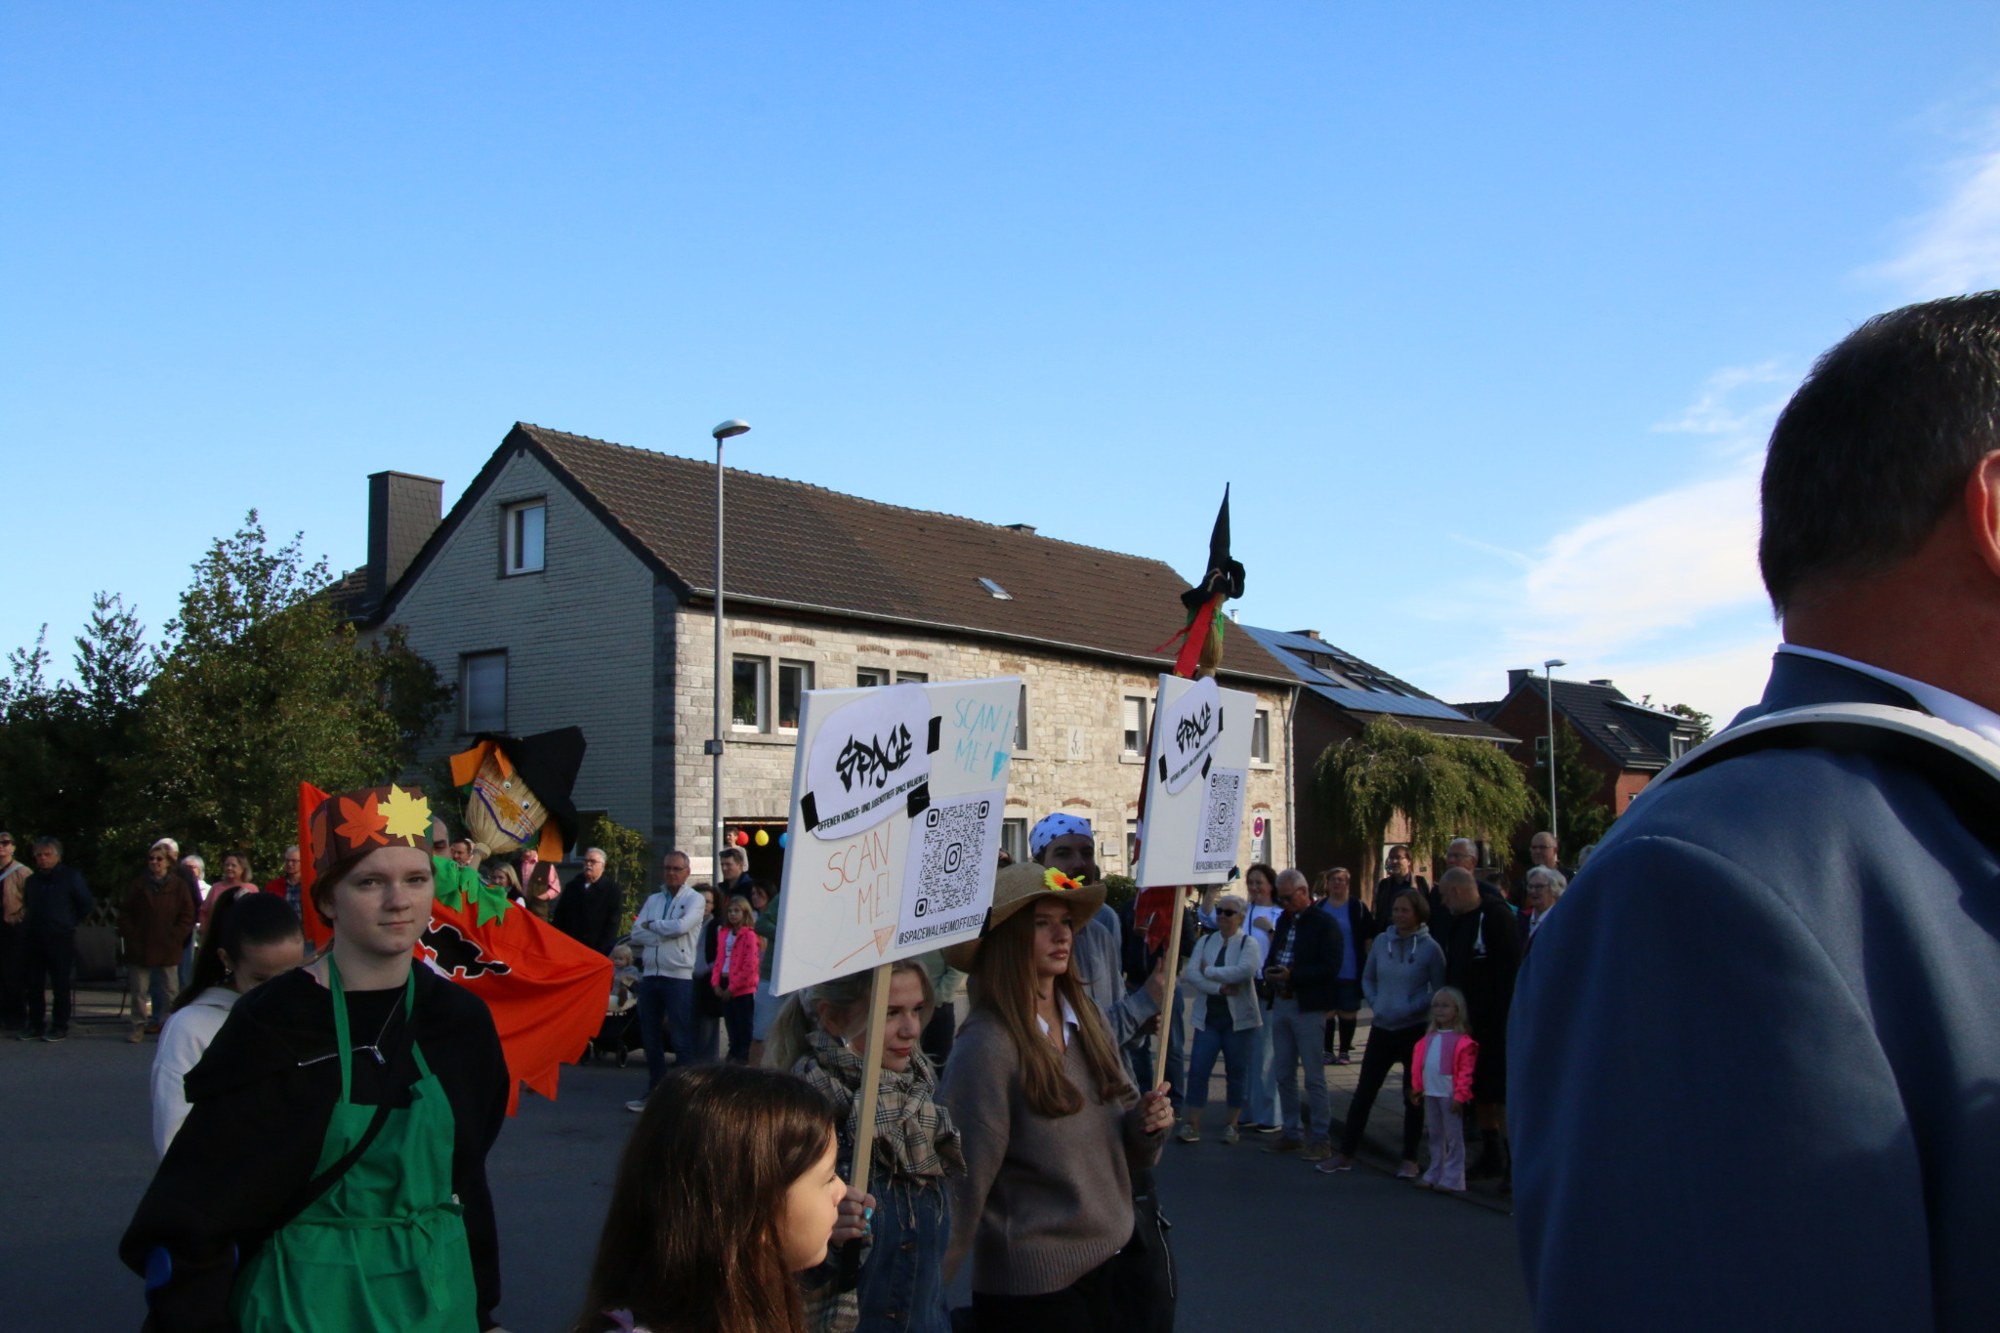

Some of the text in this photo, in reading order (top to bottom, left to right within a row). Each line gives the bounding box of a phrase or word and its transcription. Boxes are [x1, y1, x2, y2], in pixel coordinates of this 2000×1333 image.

[953, 698, 1004, 740] SCAN
[1176, 701, 1212, 755] SPACE
[836, 722, 912, 793] SPACE
[817, 815, 841, 832] OFFENER
[841, 807, 861, 822] KINDER-
[861, 802, 871, 814] UND
[895, 784, 907, 796] SPACE
[823, 822, 891, 892] SCAN
[858, 869, 890, 925] ME!
[898, 912, 985, 945] @SPACEWALHEIMOFFIZIELL
